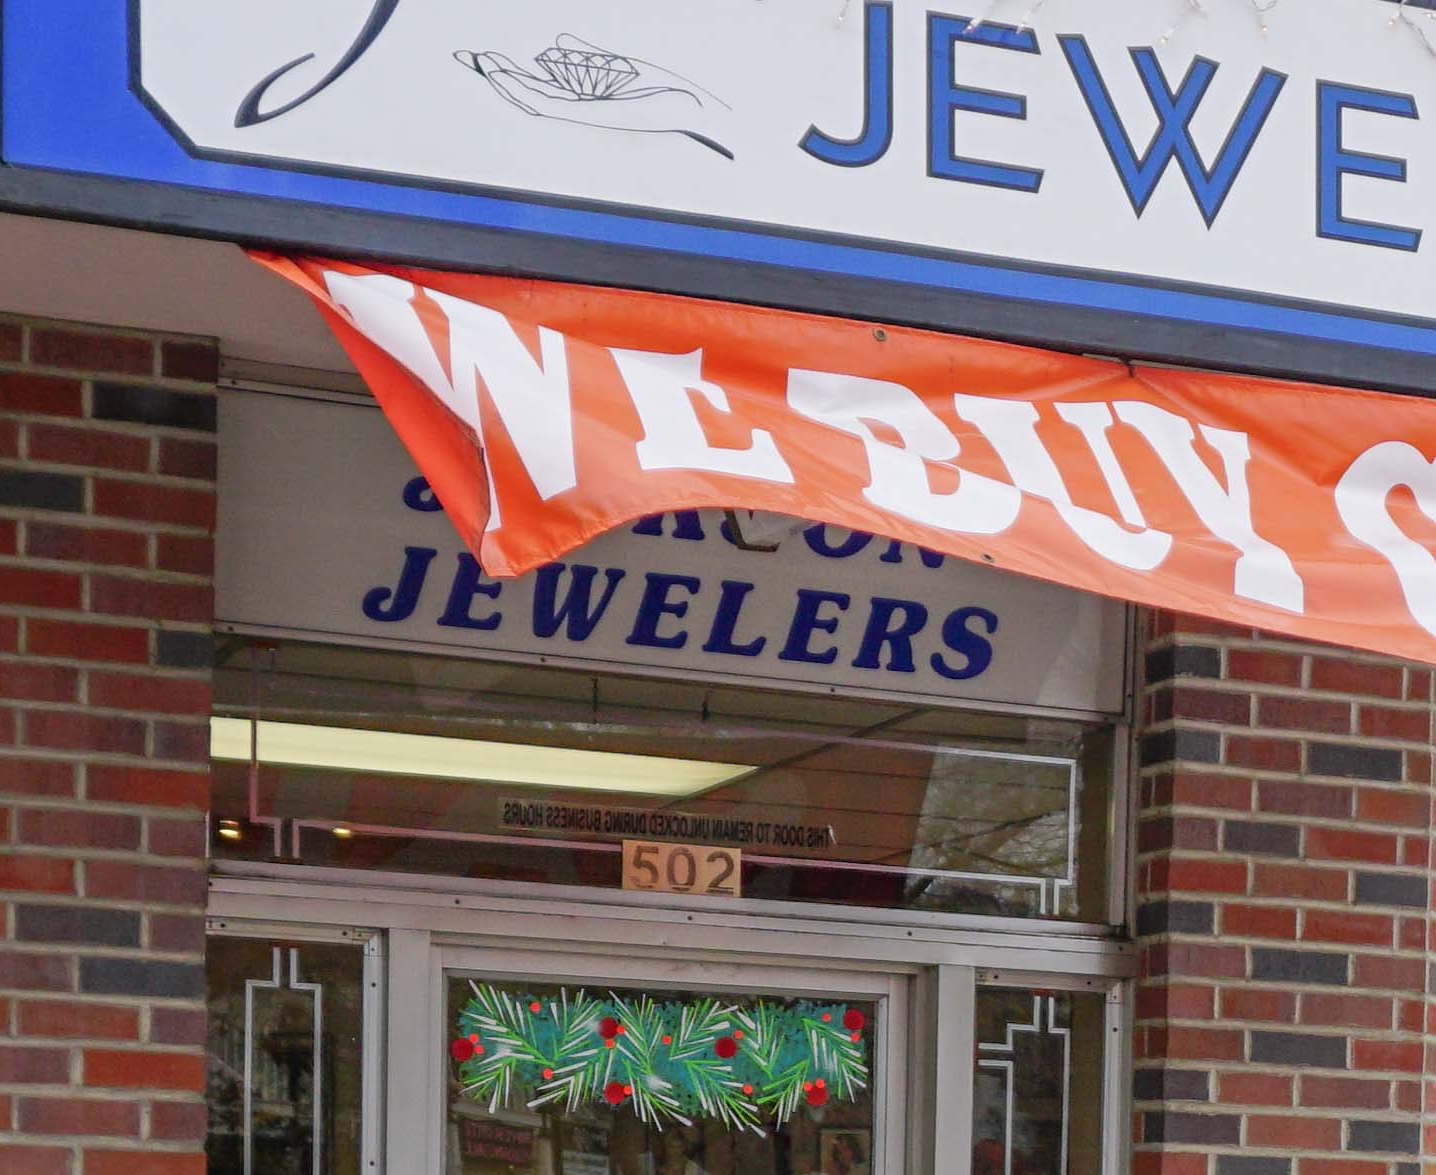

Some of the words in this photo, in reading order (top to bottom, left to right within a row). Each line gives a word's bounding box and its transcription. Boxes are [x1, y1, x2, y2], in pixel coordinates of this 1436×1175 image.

[322, 268, 793, 531] WE
[785, 367, 1303, 613] BUY
[362, 546, 998, 680] JEWELERS
[631, 845, 735, 893] 502
